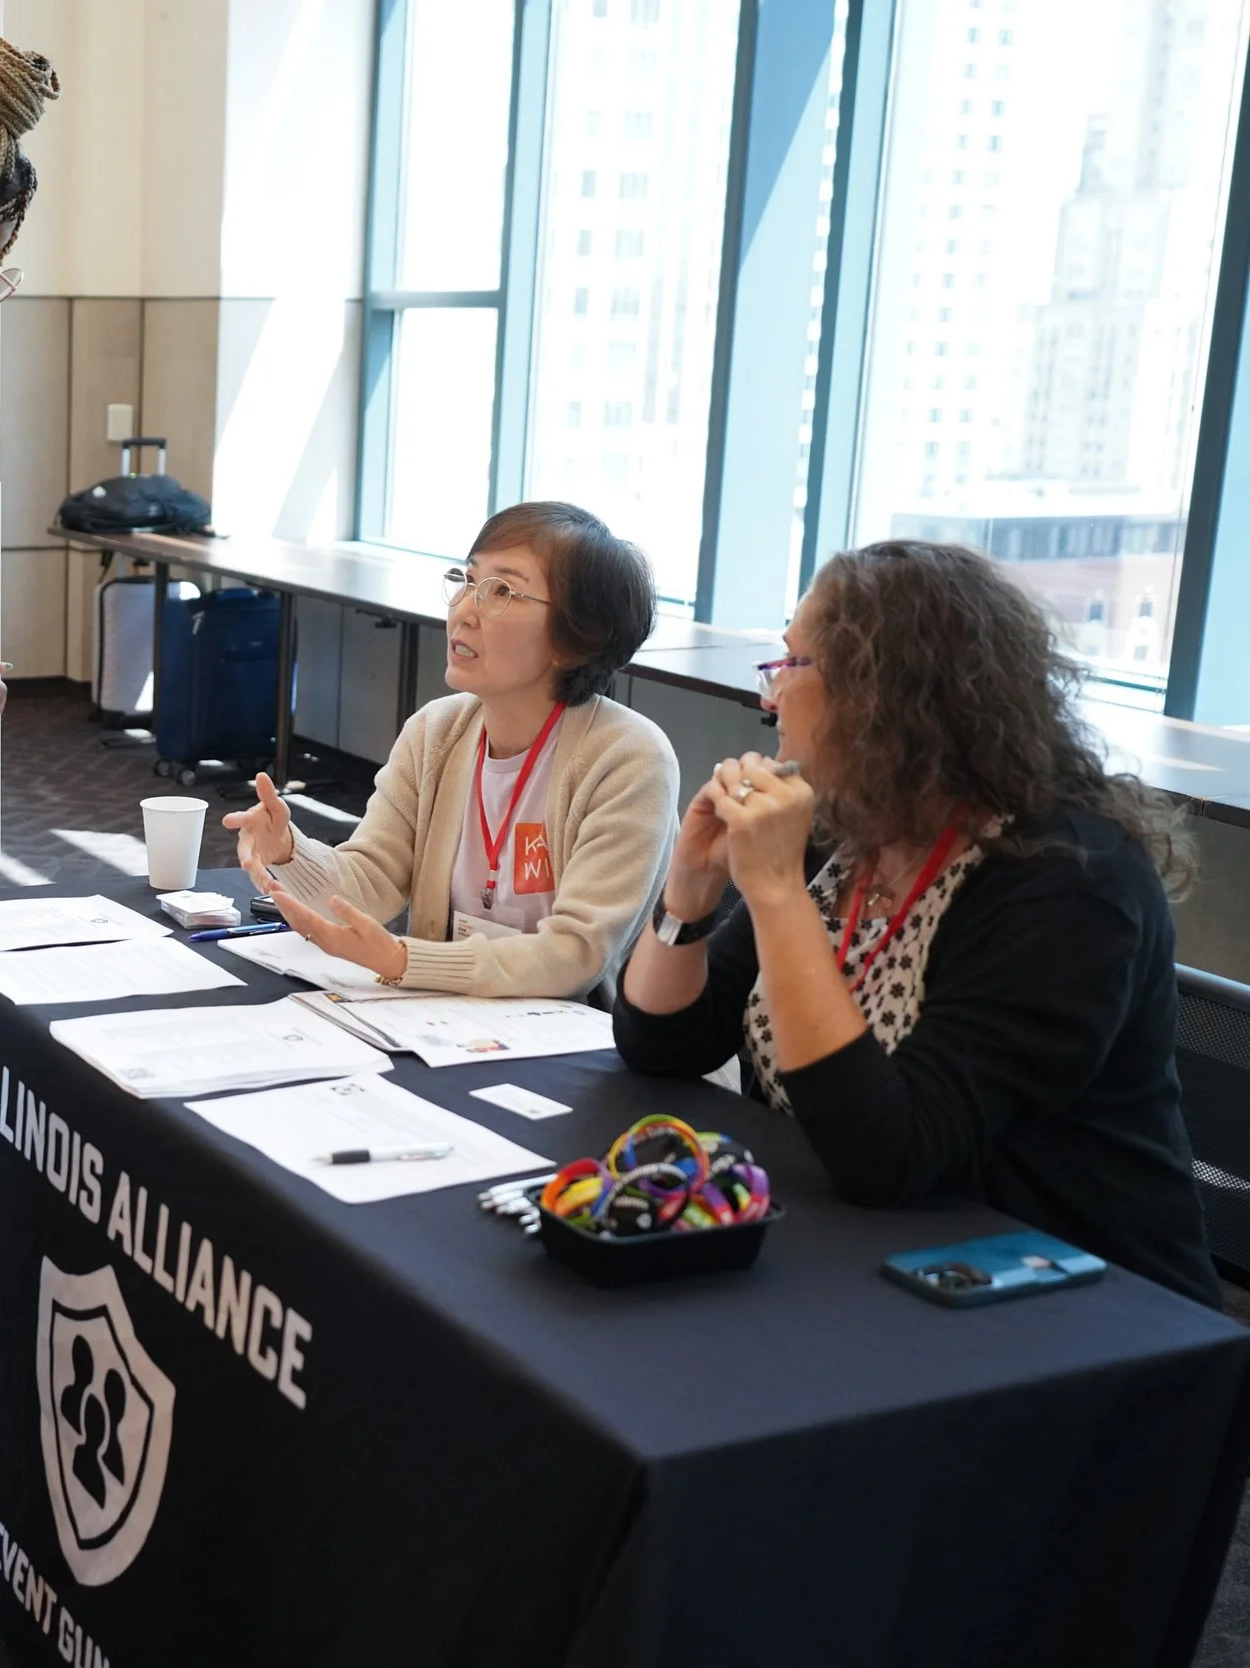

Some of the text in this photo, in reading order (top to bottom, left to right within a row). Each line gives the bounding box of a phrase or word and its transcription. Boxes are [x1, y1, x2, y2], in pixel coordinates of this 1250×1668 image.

[525, 834, 549, 856] KA
[524, 858, 550, 880] WI
[107, 1170, 312, 1411] ALLIANCE
